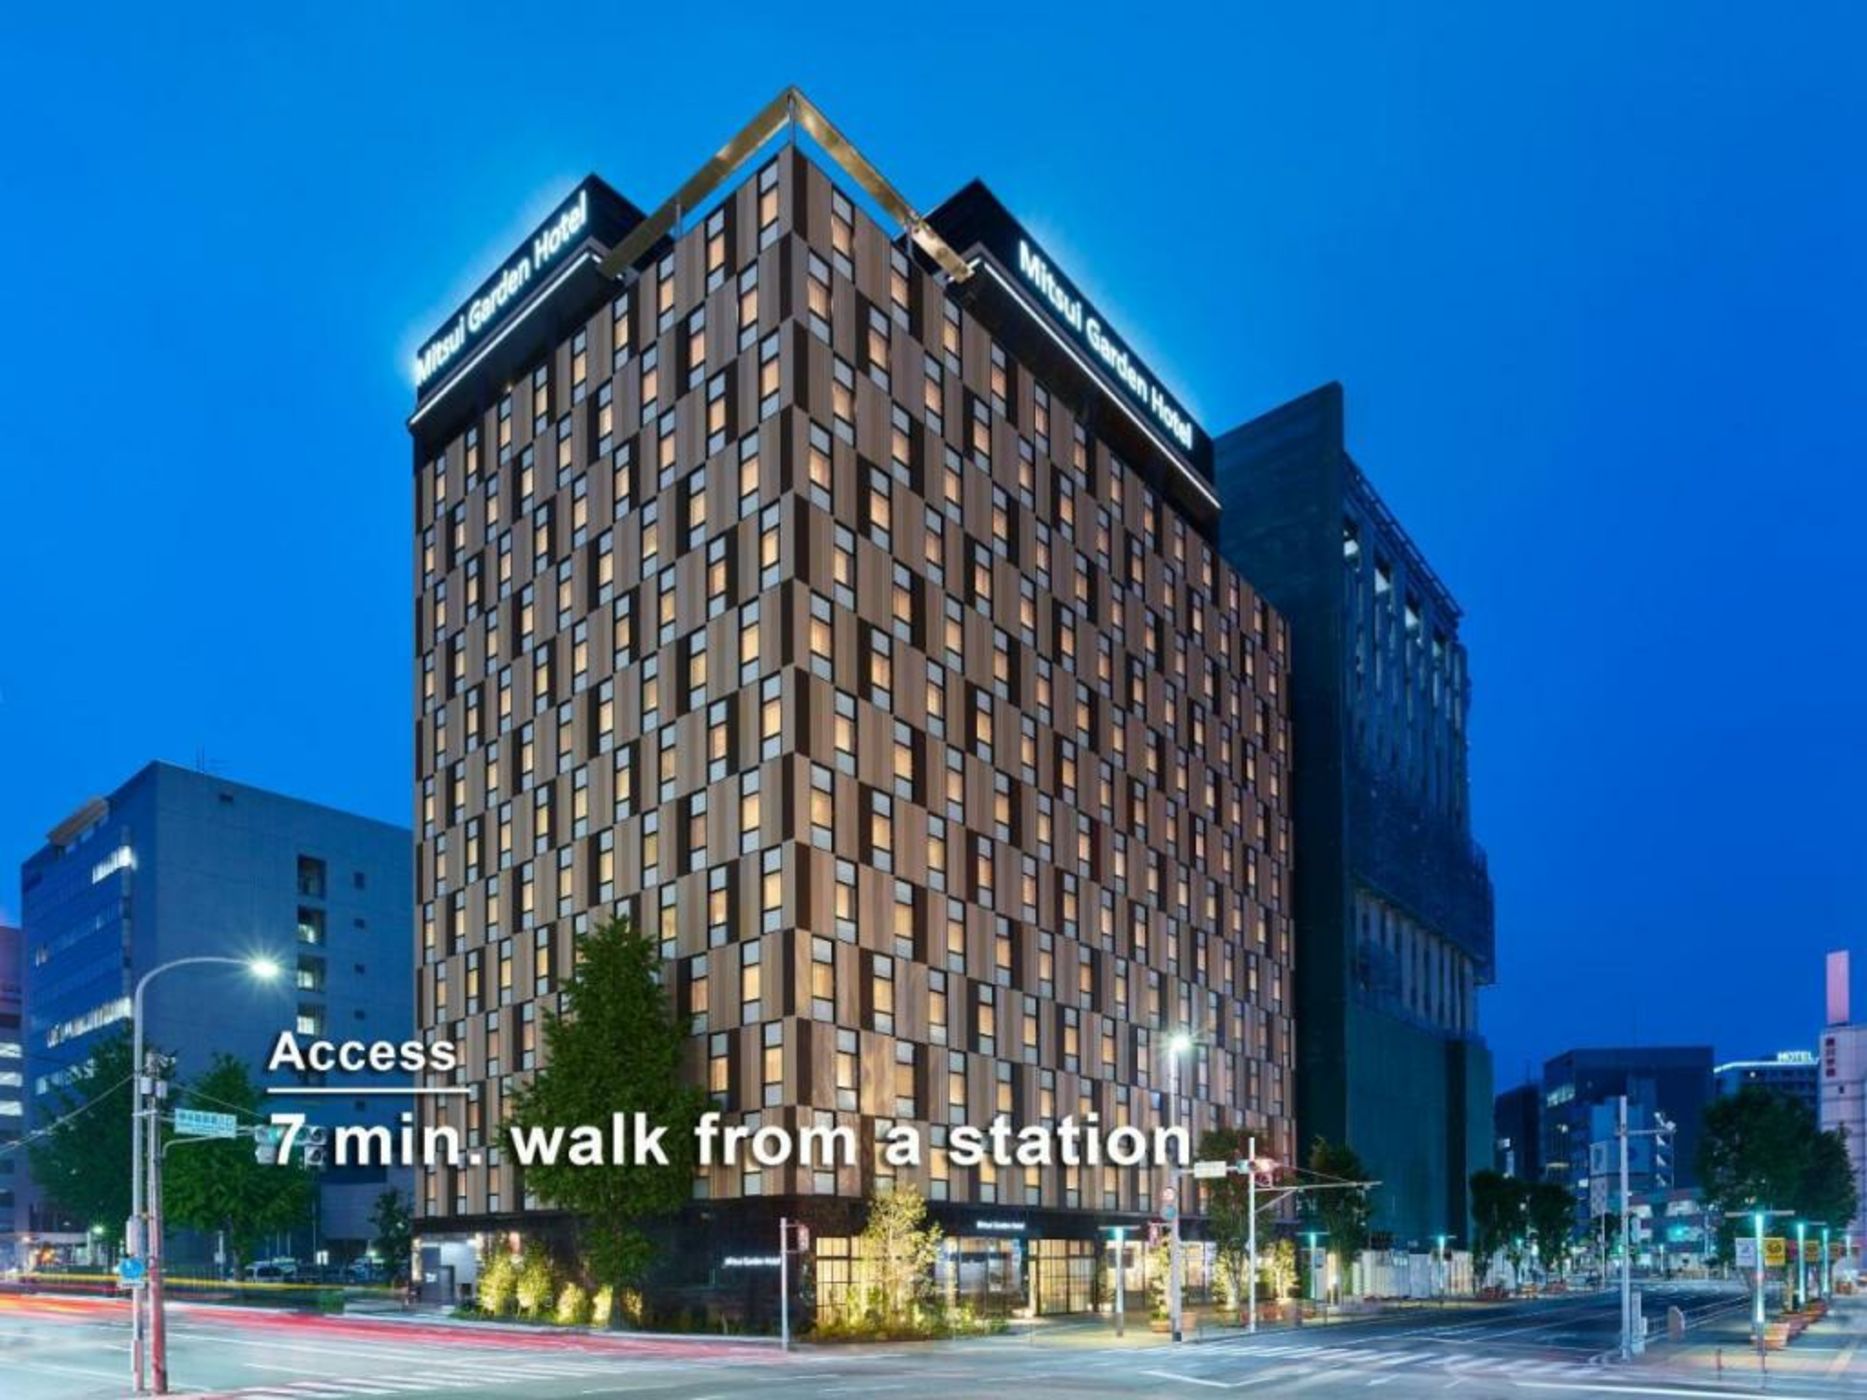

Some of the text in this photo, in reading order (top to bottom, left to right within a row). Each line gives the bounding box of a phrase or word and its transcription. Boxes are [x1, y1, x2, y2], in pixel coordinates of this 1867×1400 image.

[416, 189, 588, 386] Mitsui Garden Hotel
[1018, 239, 1194, 451] Mitsui Garden Hotel
